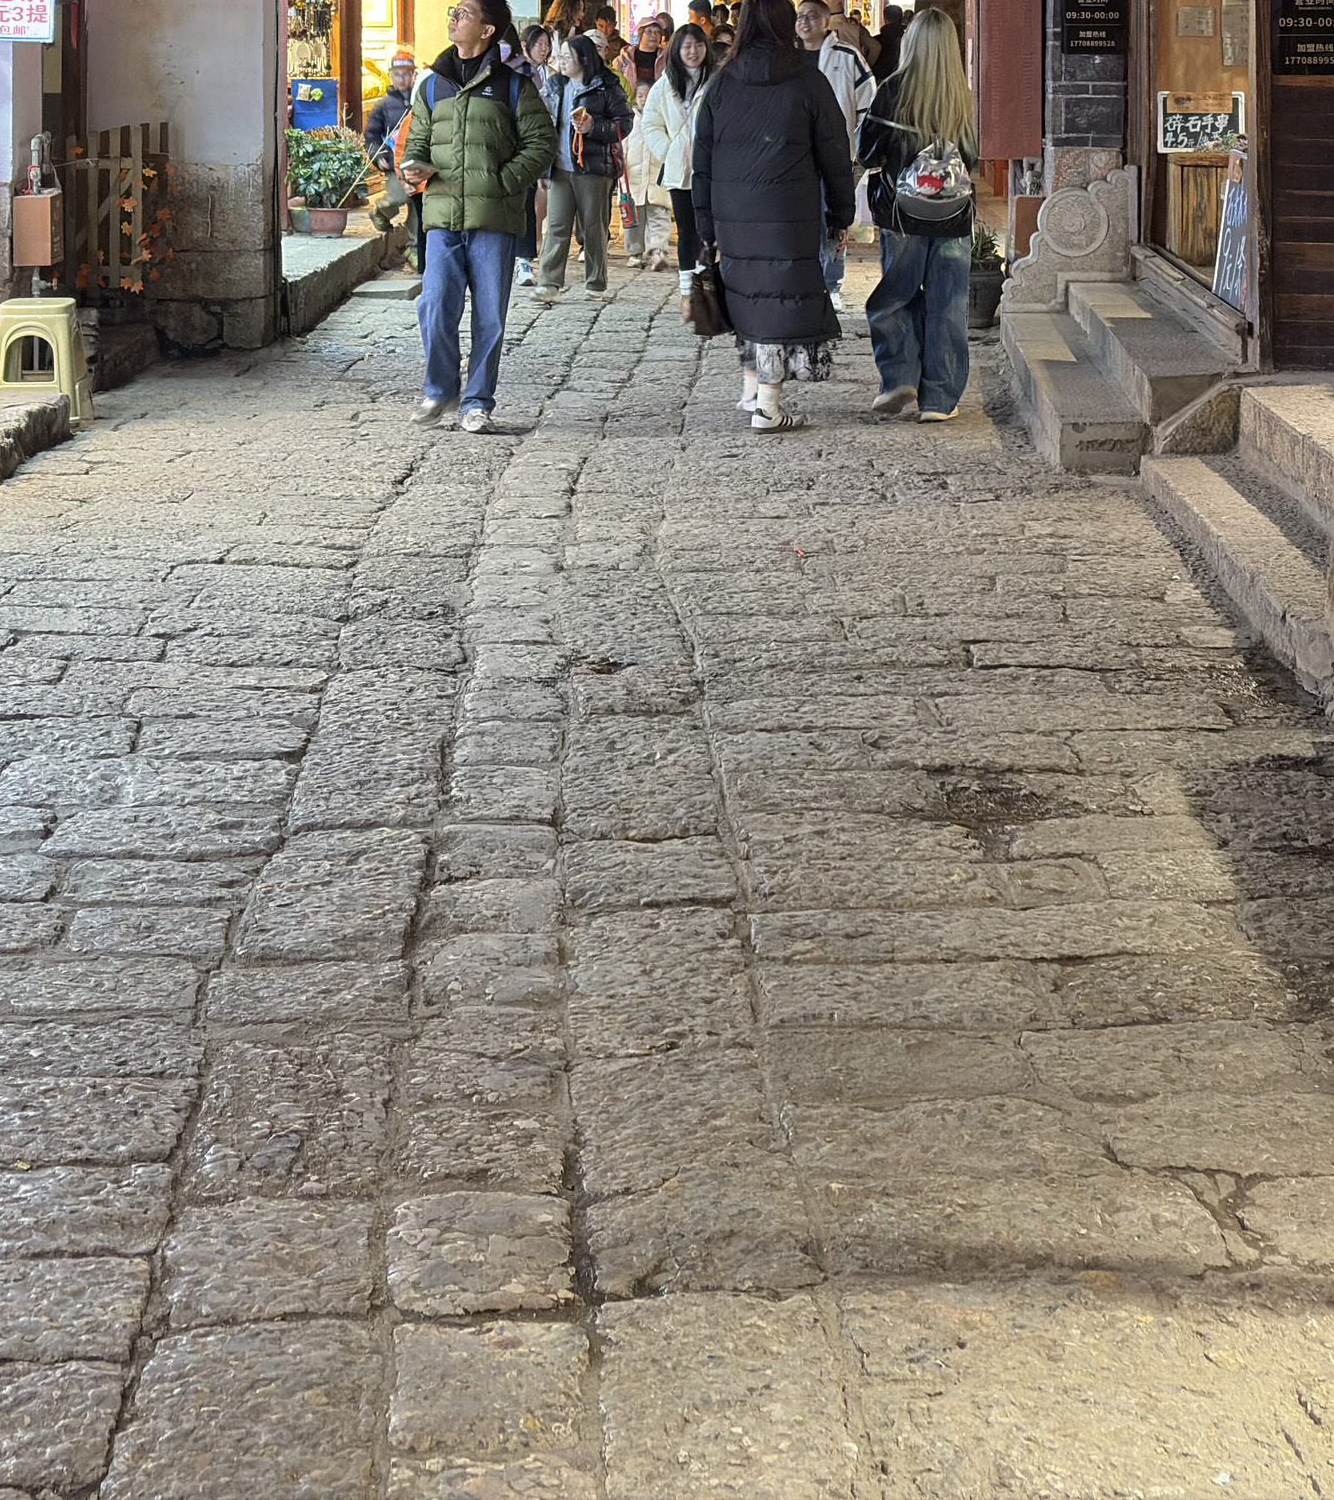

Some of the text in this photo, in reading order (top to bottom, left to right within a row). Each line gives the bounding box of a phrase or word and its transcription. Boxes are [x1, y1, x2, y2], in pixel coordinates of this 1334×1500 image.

[1066, 11, 1119, 20] 09:30-00:00
[1079, 30, 1106, 38] 加盟热线
[1069, 40, 1115, 48] 17708899528
[1296, 43, 1334, 52] 加盟热线
[1164, 114, 1230, 133] 碎石手串
